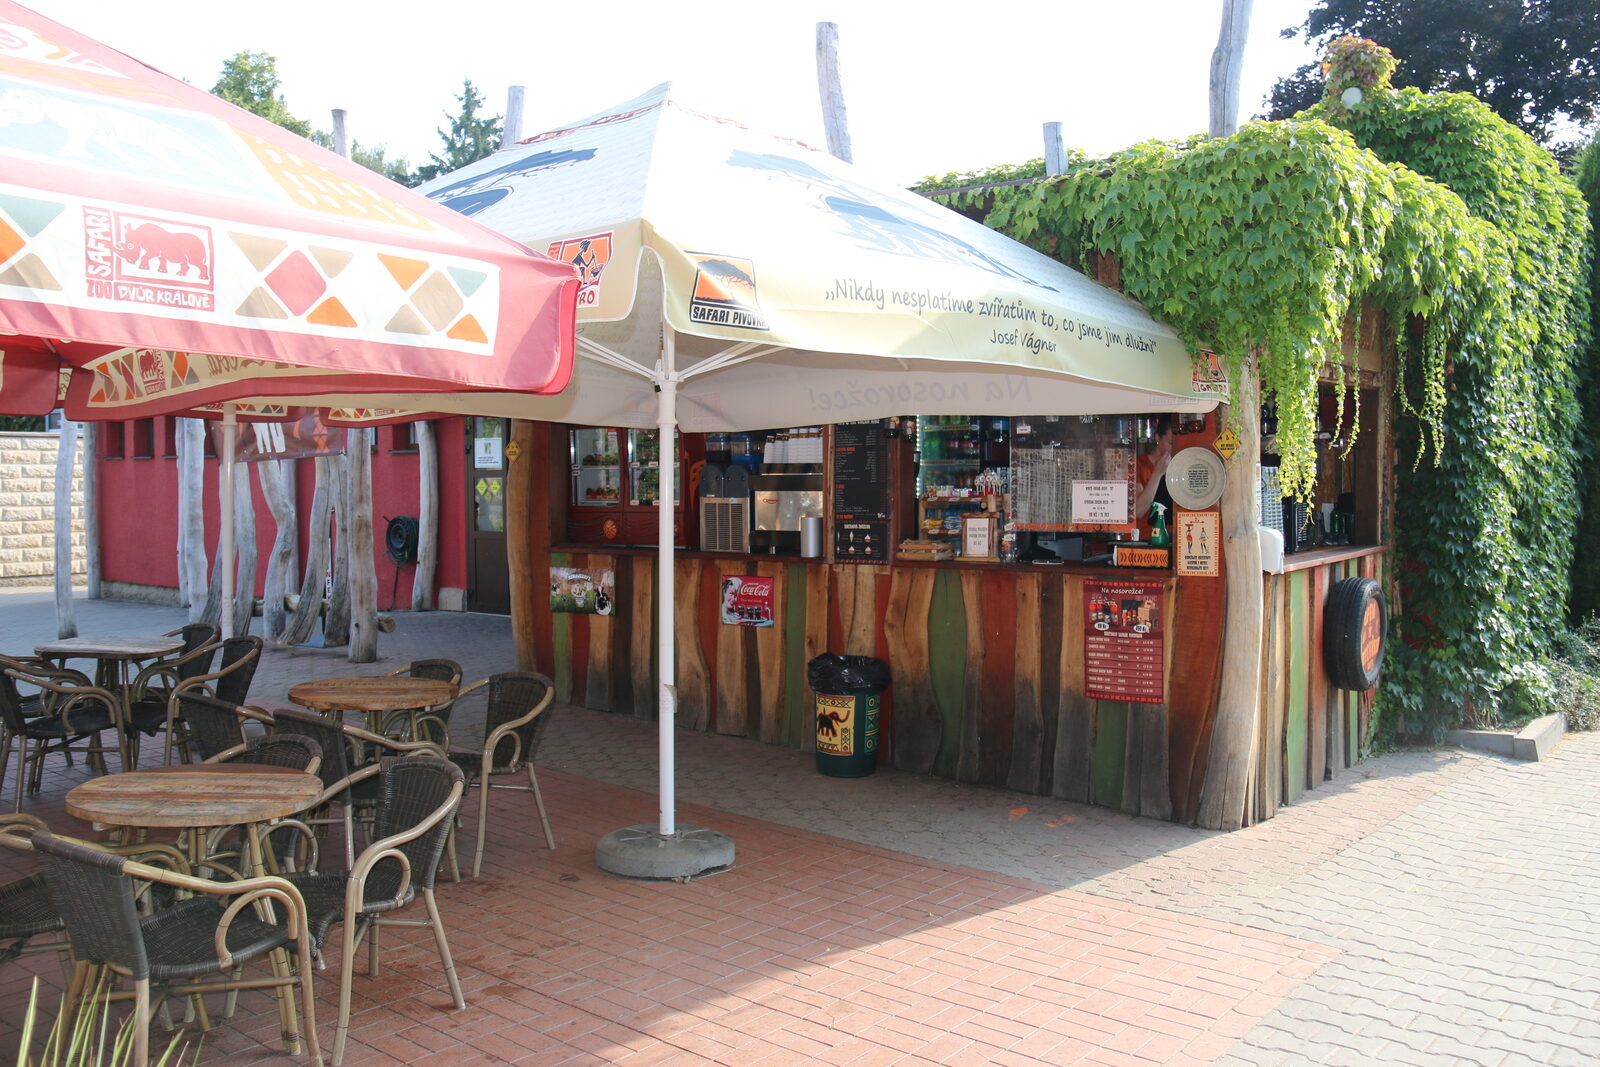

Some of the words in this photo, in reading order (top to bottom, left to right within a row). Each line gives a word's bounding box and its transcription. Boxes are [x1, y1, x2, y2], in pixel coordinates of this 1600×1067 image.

[84, 208, 112, 277] SAFARI
[86, 278, 113, 299] ZOO
[117, 285, 155, 303] DVŮR
[156, 290, 210, 309] KRÁLOVÉ
[692, 306, 730, 323] SAFARI
[979, 296, 1037, 323] zvířatům
[1063, 318, 1075, 332] co
[1077, 318, 1103, 341] jsme
[990, 328, 1019, 346] Josef
[1020, 333, 1058, 354] Vágner
